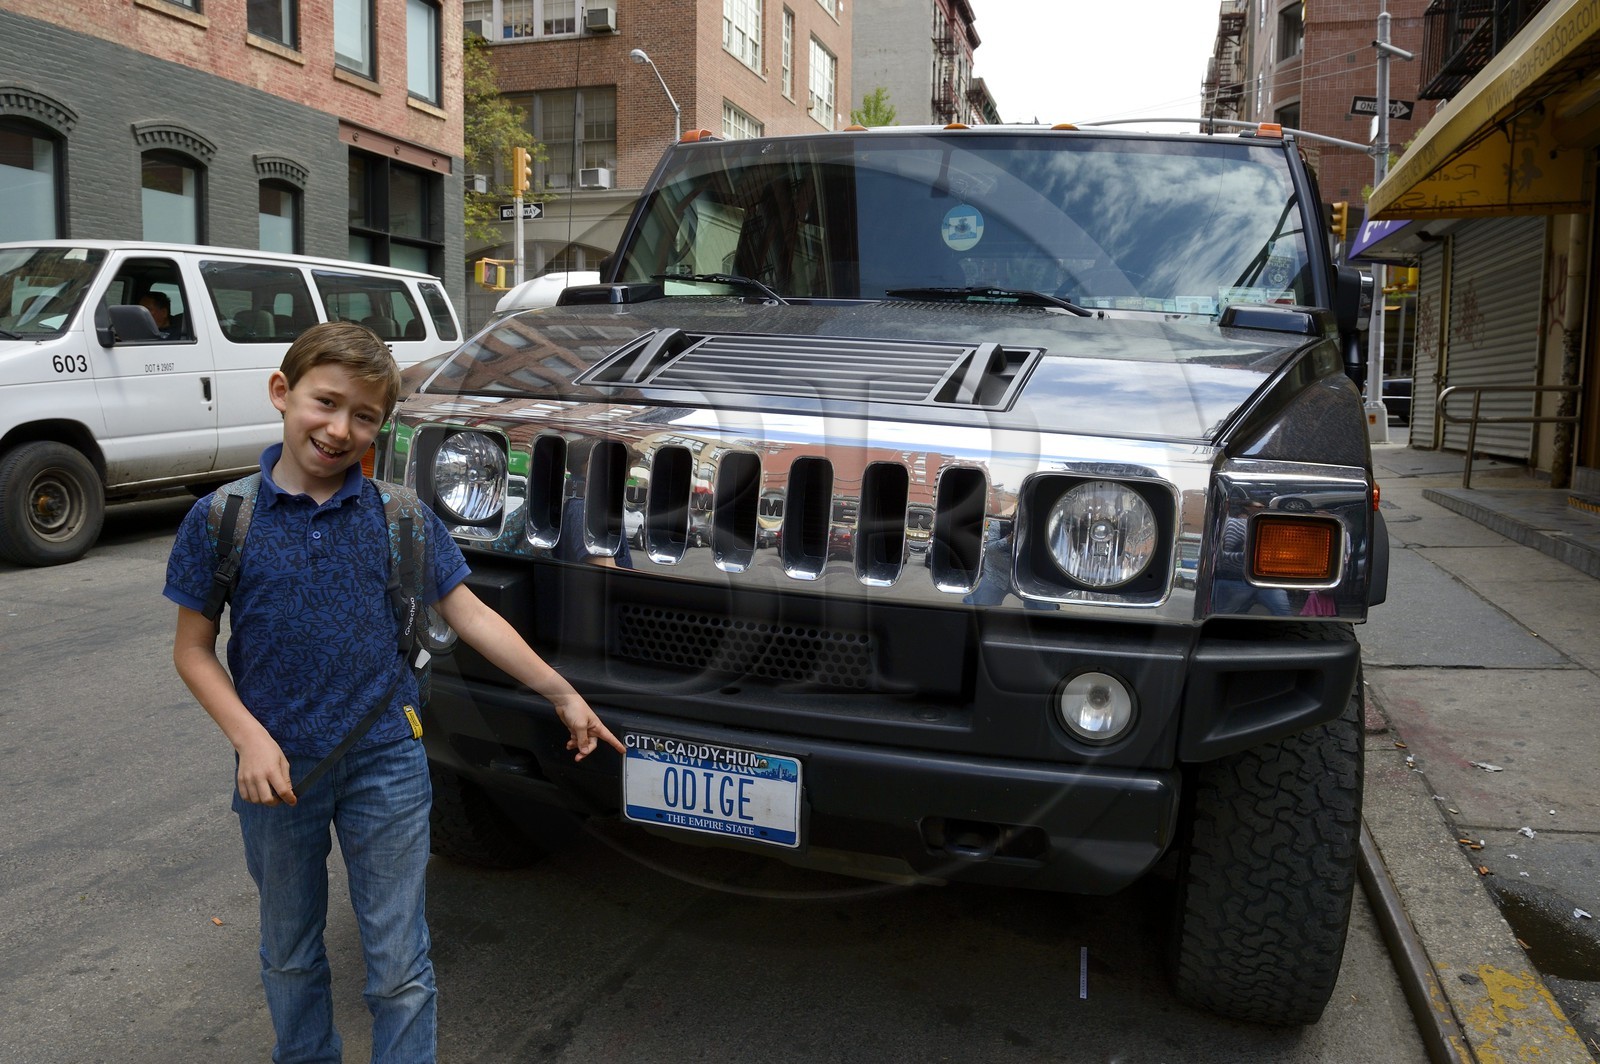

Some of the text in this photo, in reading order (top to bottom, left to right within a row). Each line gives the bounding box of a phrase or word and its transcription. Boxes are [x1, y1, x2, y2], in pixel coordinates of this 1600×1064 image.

[52, 355, 88, 373] 603
[145, 364, 156, 373] DOT
[624, 734, 661, 750] CITY
[666, 813, 754, 836] THE EMPIRE STATE
